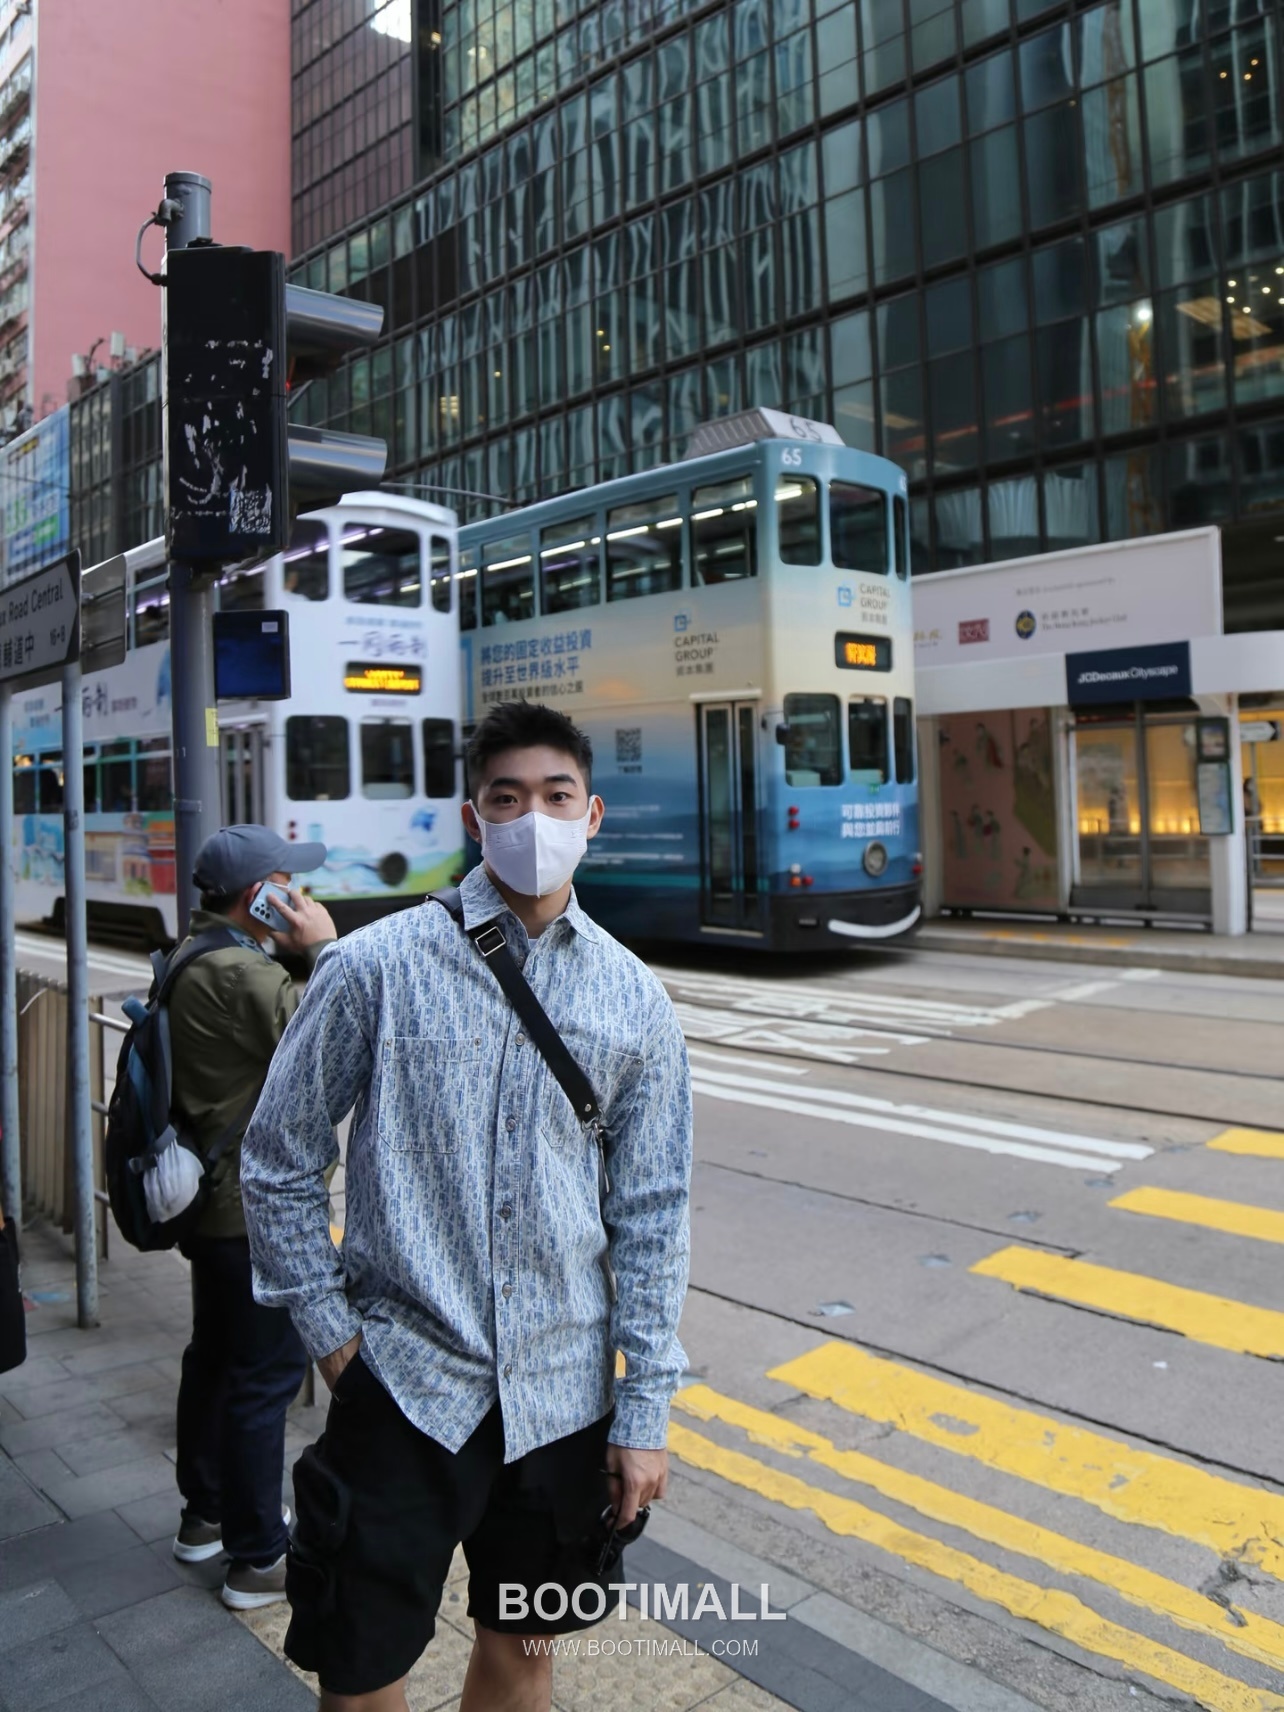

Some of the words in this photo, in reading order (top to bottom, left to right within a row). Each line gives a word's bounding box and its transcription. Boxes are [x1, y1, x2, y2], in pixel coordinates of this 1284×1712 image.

[781, 447, 802, 465] 65
[860, 583, 891, 598] CAPITAL
[9, 593, 28, 621] Road
[31, 578, 63, 613] Central
[861, 597, 887, 610] GROUP
[674, 632, 720, 649] CAPITAL
[675, 647, 715, 662] GROUP
